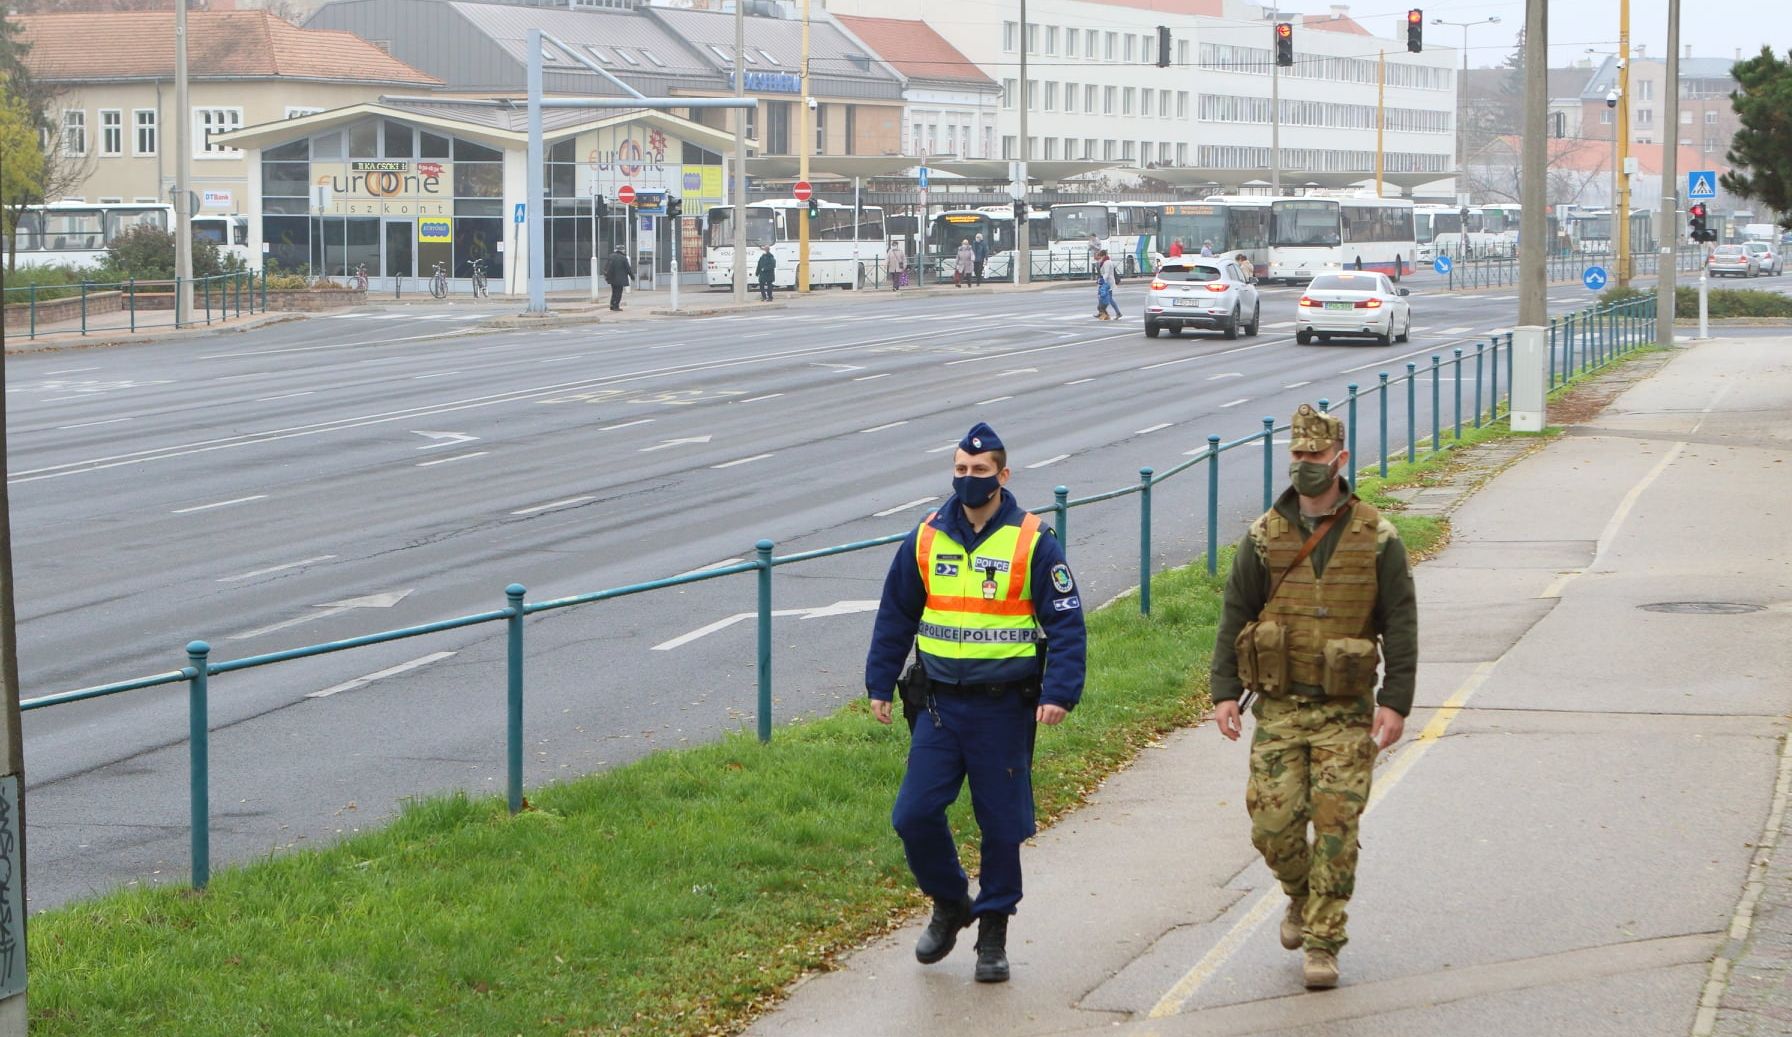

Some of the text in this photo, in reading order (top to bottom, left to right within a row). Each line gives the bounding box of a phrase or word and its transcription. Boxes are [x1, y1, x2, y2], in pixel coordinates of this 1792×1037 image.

[976, 558, 1009, 571] POLICE
[925, 625, 958, 640] POLICE
[963, 630, 1017, 641] POLICE
